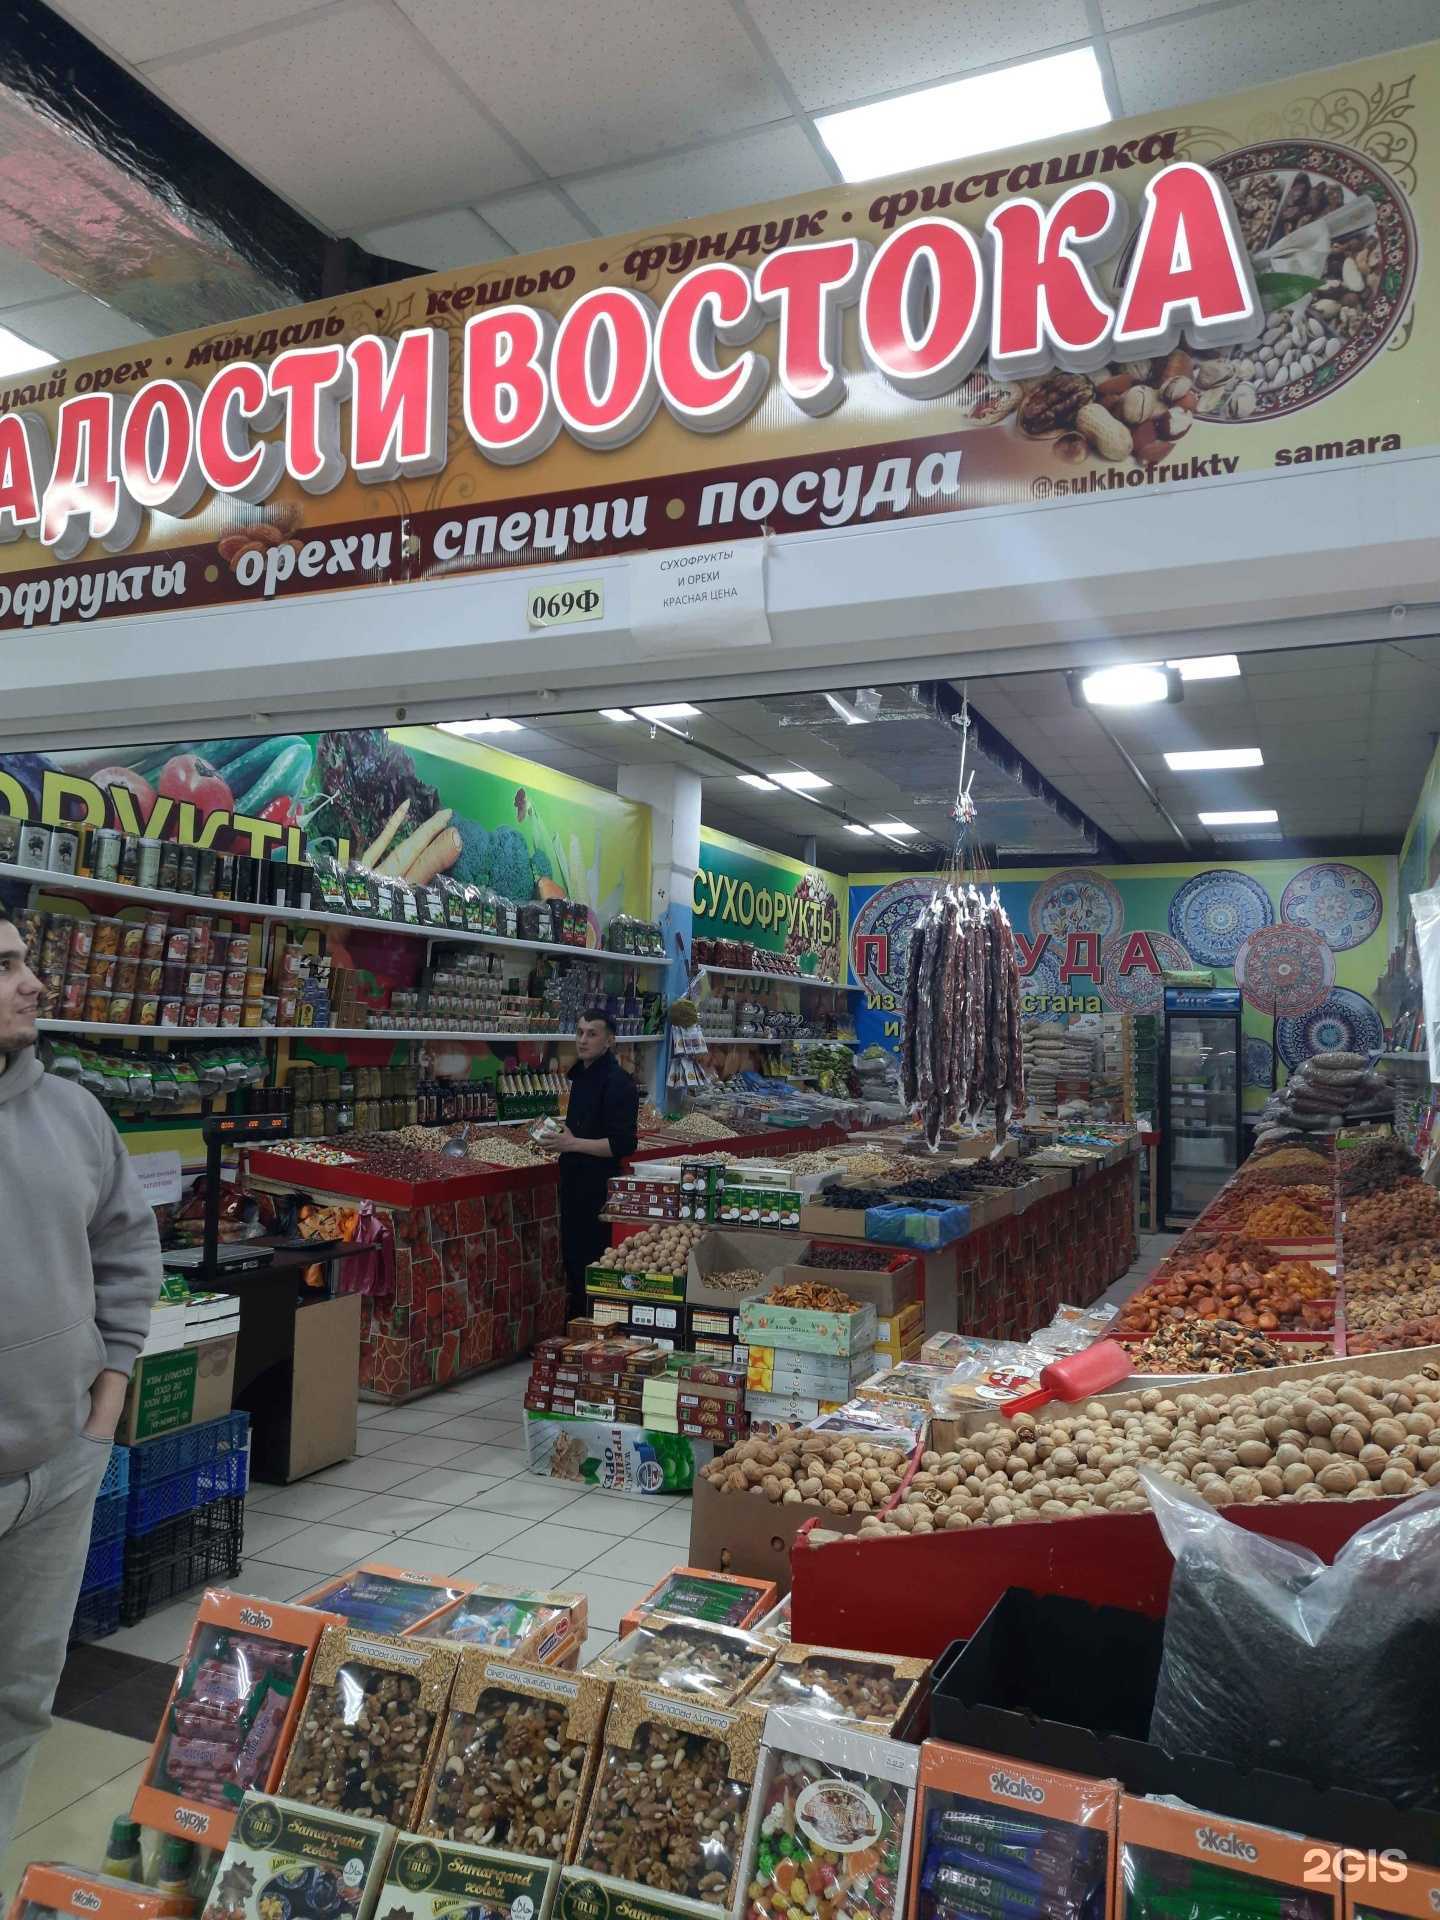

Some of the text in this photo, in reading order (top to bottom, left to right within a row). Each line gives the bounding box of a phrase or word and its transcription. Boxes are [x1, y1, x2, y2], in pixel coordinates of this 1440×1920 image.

[868, 130, 1179, 230] фисташка
[624, 208, 828, 282] фундук
[426, 265, 576, 315] кешью
[464, 161, 1258, 451] ВОСТОКА
[185, 311, 345, 369] миндаль
[75, 357, 152, 392] орех
[1274, 433, 1401, 467] samara
[236, 532, 393, 596] орехи
[432, 495, 649, 560] специи
[698, 447, 963, 525] посуда
[659, 550, 734, 571] СУХОФРУКТЫ
[677, 571, 720, 587] И ОРЕХИ
[532, 589, 600, 619] 069Ф
[663, 586, 738, 608] КРАСНАЯ ЦЕНА
[691, 867, 838, 944] СУХОФРУКТЫ
[855, 931, 1163, 985] ПУДА
